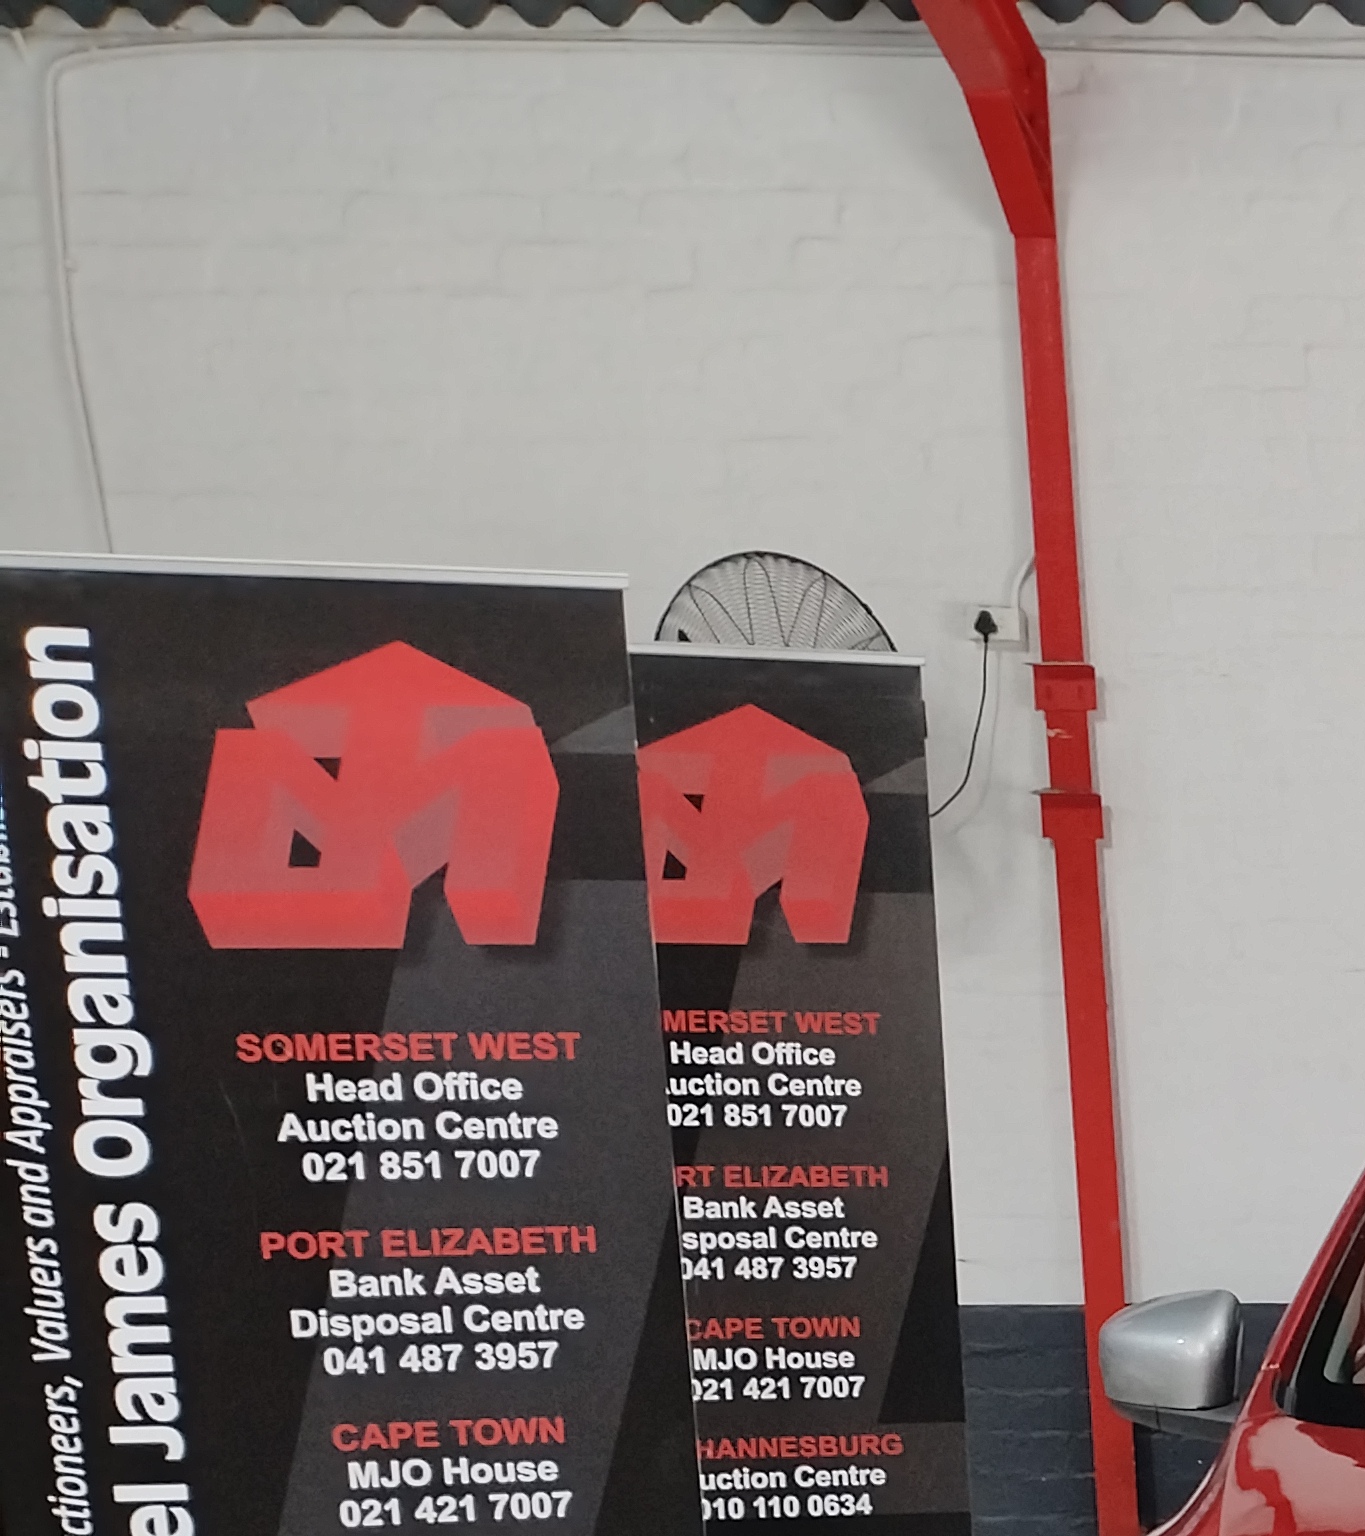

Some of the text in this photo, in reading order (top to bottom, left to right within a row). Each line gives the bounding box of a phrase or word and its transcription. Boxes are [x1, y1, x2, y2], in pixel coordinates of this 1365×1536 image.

[22, 625, 153, 1178] Organisation
[662, 1009, 880, 1035] MERSET WEST
[0, 969, 53, 1155] Appraisers
[236, 1031, 581, 1063] SOMERSET WEST
[669, 1040, 836, 1066] Head Office
[305, 1071, 524, 1103] Head Office
[666, 1072, 862, 1097] uction Centre
[277, 1110, 559, 1143] Auction Centre
[667, 1103, 848, 1128] 021 851 7007
[302, 1149, 541, 1182] 021 851 7007
[674, 1165, 889, 1189] RT ELIZABETH
[11, 1159, 56, 1228] and
[682, 1195, 846, 1220] Bank Asset
[259, 1225, 597, 1261] PORT ELIZABETH
[681, 1225, 879, 1255] sposal Centre
[329, 1265, 542, 1298] Bank Asset
[734, 1256, 785, 1280] 487
[792, 1255, 858, 1280] 3957
[23, 1235, 71, 1362] Valuers
[93, 1202, 186, 1461] James
[289, 1303, 586, 1344] Disposal Centre
[772, 1316, 861, 1339] TOWN
[323, 1340, 559, 1376] 041 487 3957
[692, 1346, 856, 1371] MJO House
[742, 1376, 791, 1400] 421
[799, 1375, 866, 1399] 7007
[332, 1416, 565, 1452] CAPE TOWN
[696, 1433, 903, 1460] HANNESBURG
[347, 1456, 559, 1490] MJO House
[700, 1464, 887, 1490] uction Centre
[339, 1490, 573, 1528] 021 421 7007
[752, 1495, 801, 1519] 110
[807, 1492, 874, 1517] 0634
